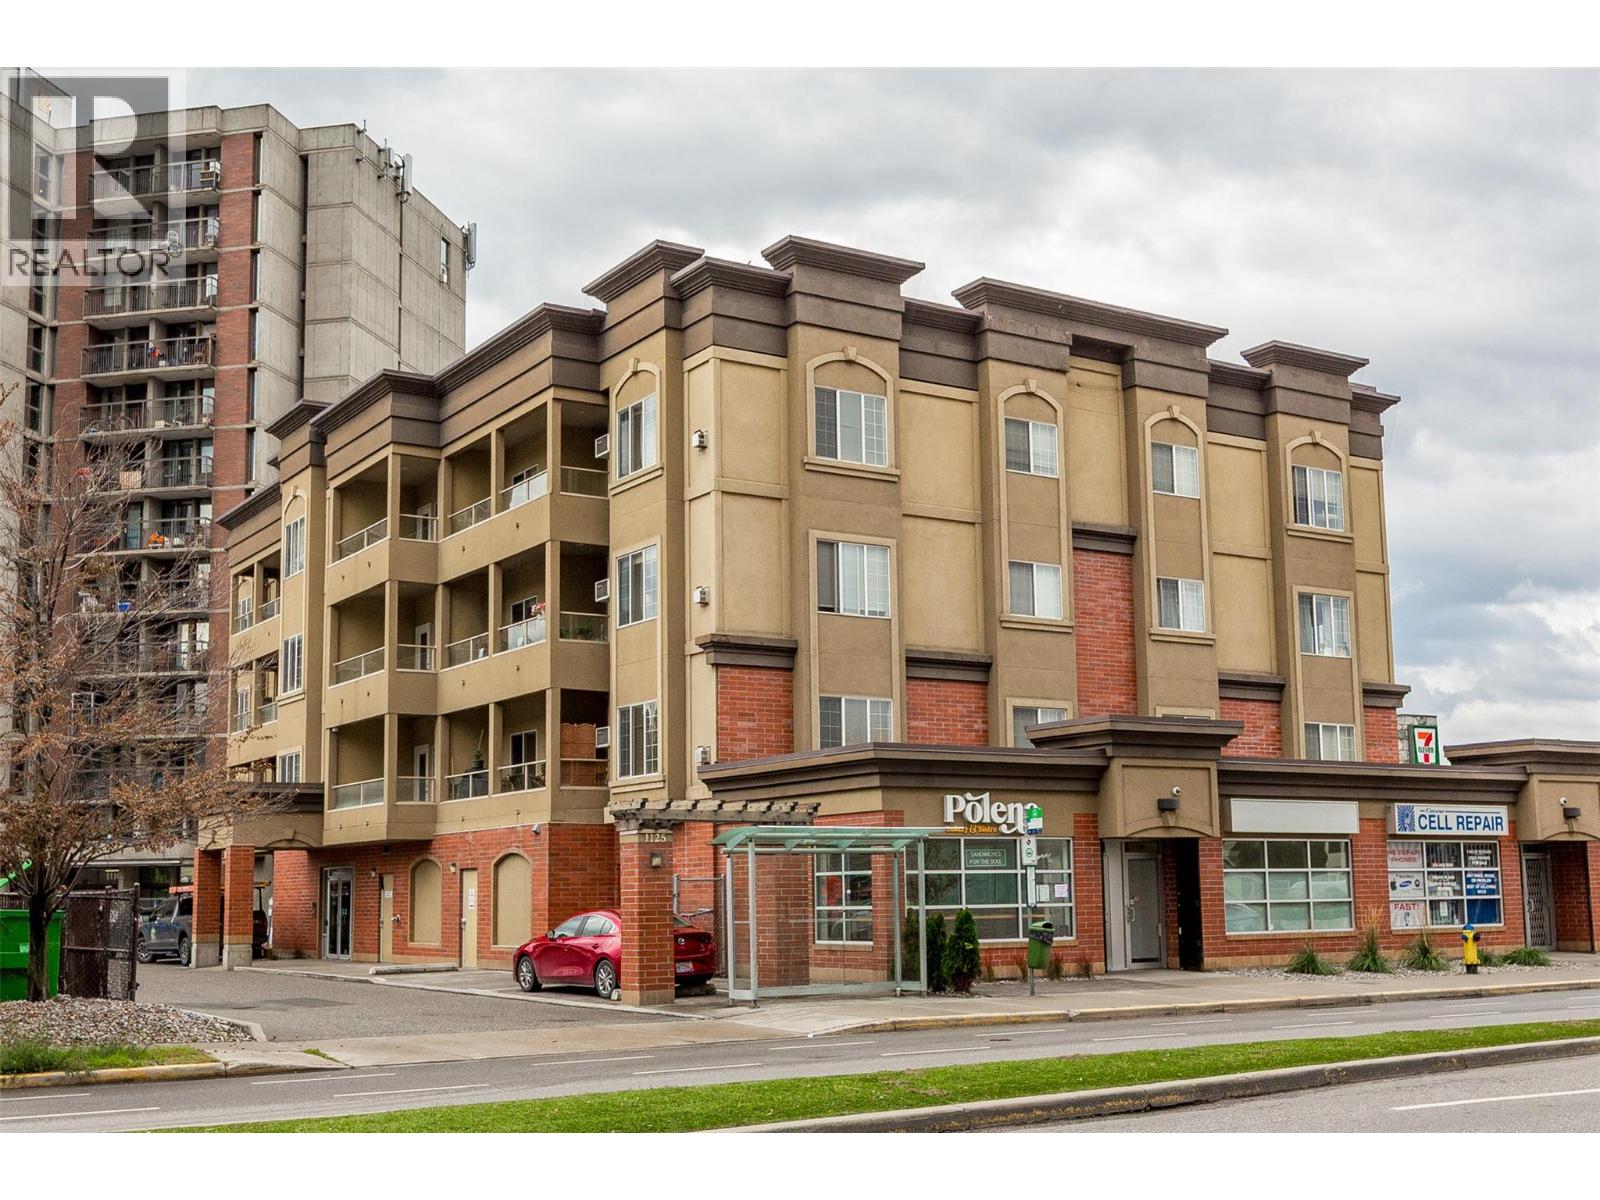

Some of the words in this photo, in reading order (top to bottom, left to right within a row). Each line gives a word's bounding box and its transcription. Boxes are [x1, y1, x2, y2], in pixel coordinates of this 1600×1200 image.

[1418, 814, 1453, 830] CELL
[1456, 815, 1504, 831] REPAIR
[645, 833, 667, 842] 1125
